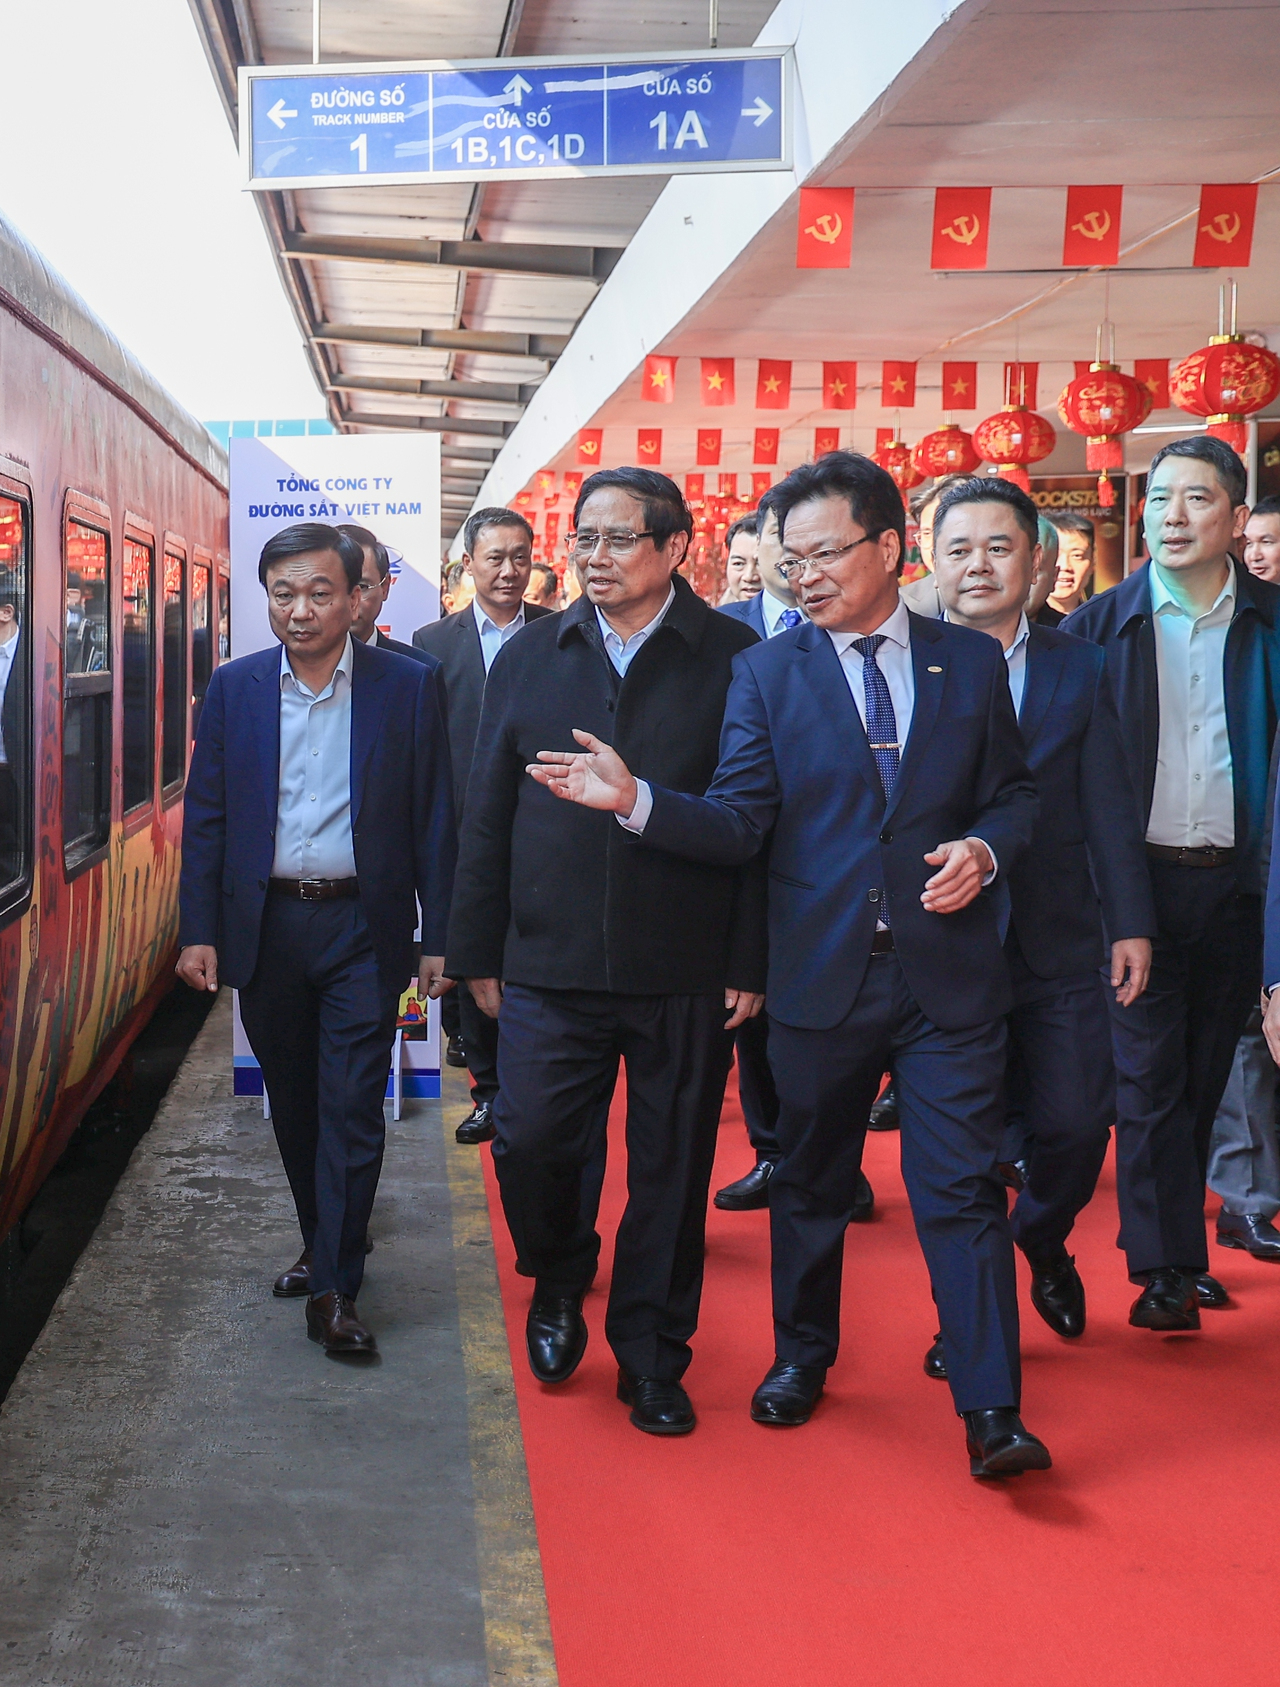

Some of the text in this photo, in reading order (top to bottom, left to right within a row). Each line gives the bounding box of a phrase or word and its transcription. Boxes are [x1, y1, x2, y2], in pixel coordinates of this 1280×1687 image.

[643, 71, 713, 95] CỬA SỐ
[311, 83, 405, 108] ĐƯỜNG SỐ
[312, 112, 405, 126] TRACK NUMBER
[483, 105, 552, 129] CỬA SỐ
[649, 110, 709, 150] 1A
[350, 133, 368, 172] 1
[451, 134, 585, 166] 1B,1C,1D
[277, 473, 393, 492] TỔNG CÔNG TY
[248, 499, 422, 518] ĐƯỜNG SẮT VIỆT NAM
